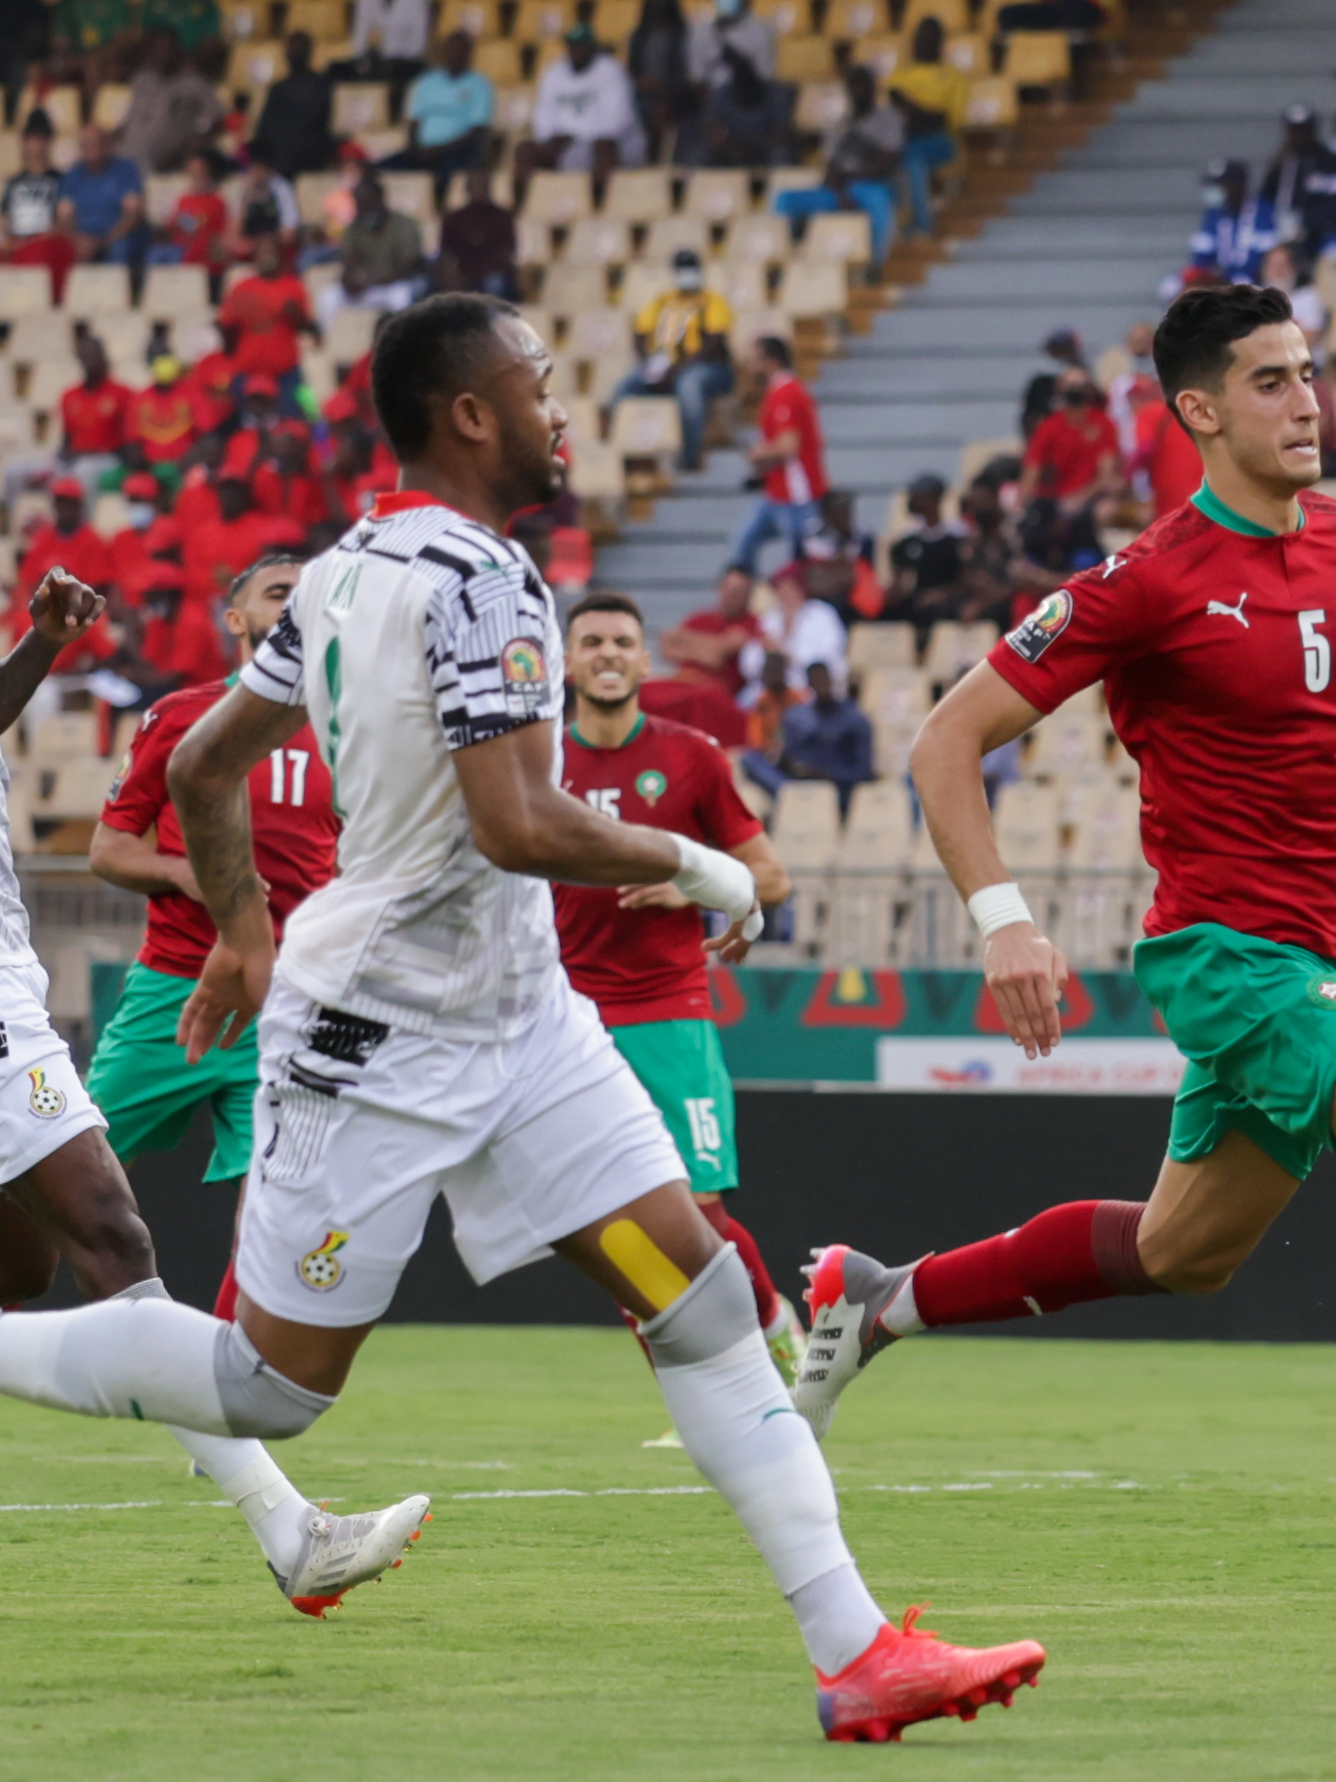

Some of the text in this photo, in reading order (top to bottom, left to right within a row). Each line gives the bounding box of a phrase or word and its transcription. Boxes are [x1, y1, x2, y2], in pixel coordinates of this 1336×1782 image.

[1297, 608, 1331, 693] 5
[270, 748, 310, 807] 17
[683, 1096, 722, 1150] 15
